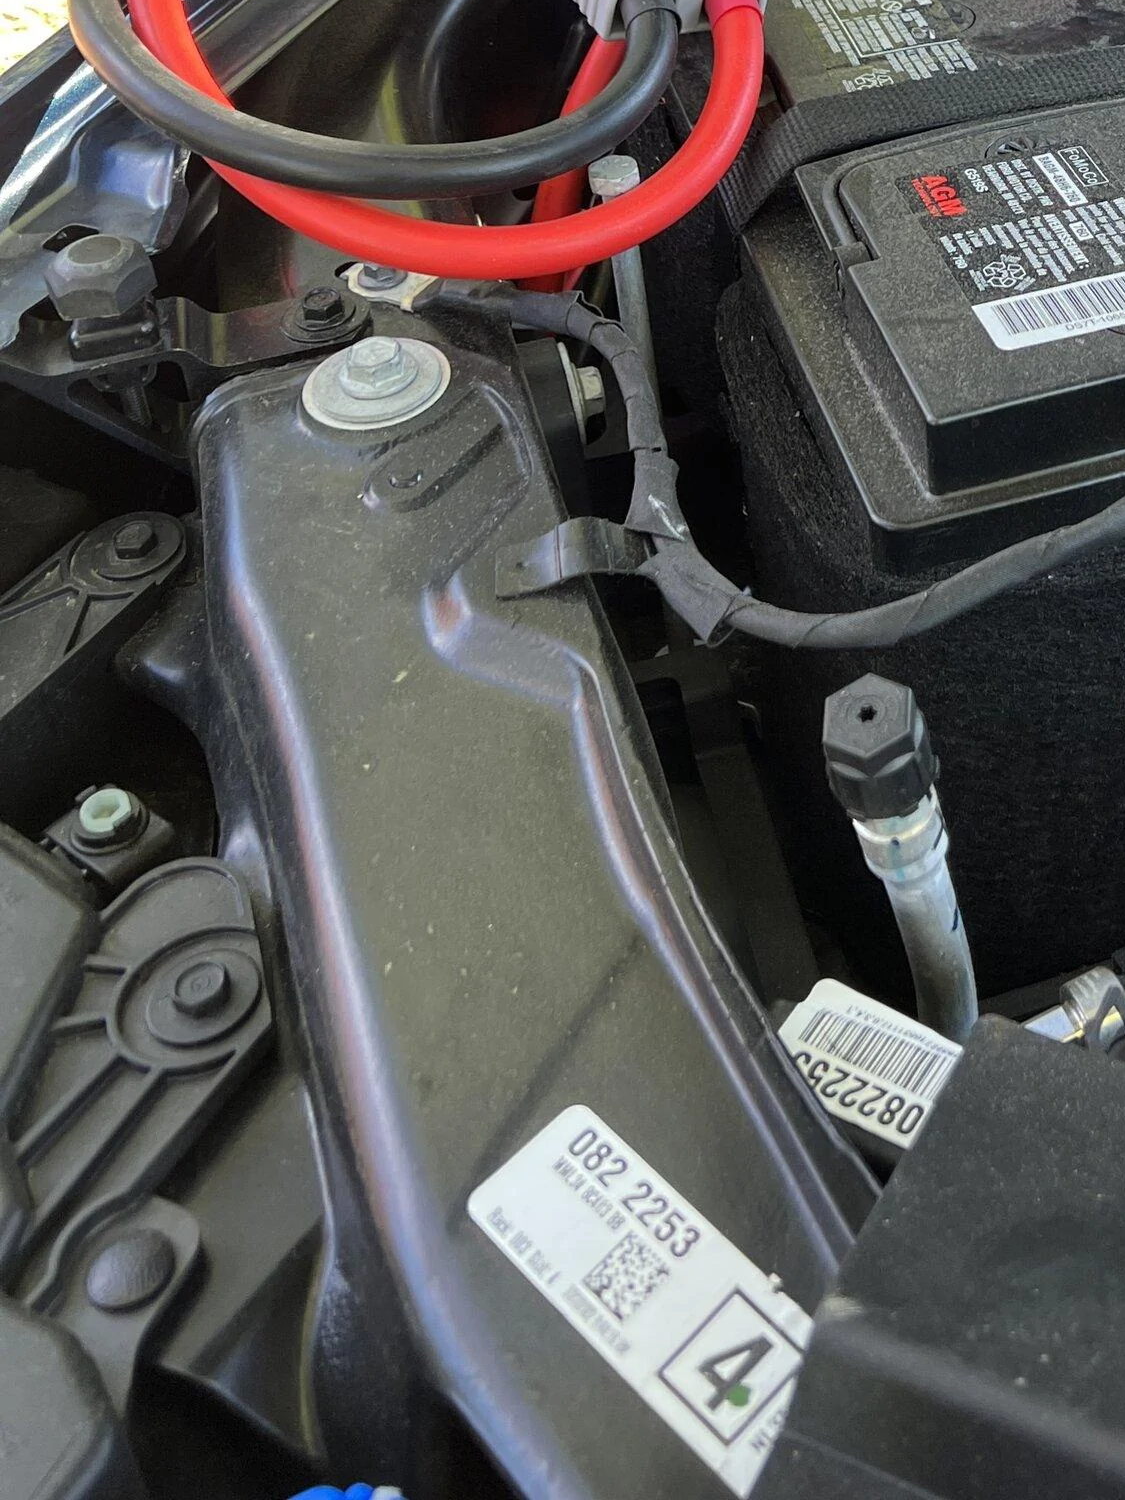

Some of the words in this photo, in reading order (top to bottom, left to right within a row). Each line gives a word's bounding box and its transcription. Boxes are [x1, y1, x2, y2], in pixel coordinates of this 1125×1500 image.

[962, 168, 989, 193] G519S
[1064, 147, 1100, 184] FoMoCo
[920, 173, 968, 217] AGM
[1071, 223, 1090, 237] 760
[567, 1128, 628, 1188] 082
[622, 1182, 701, 1259] 2253
[698, 1330, 773, 1411] 4
